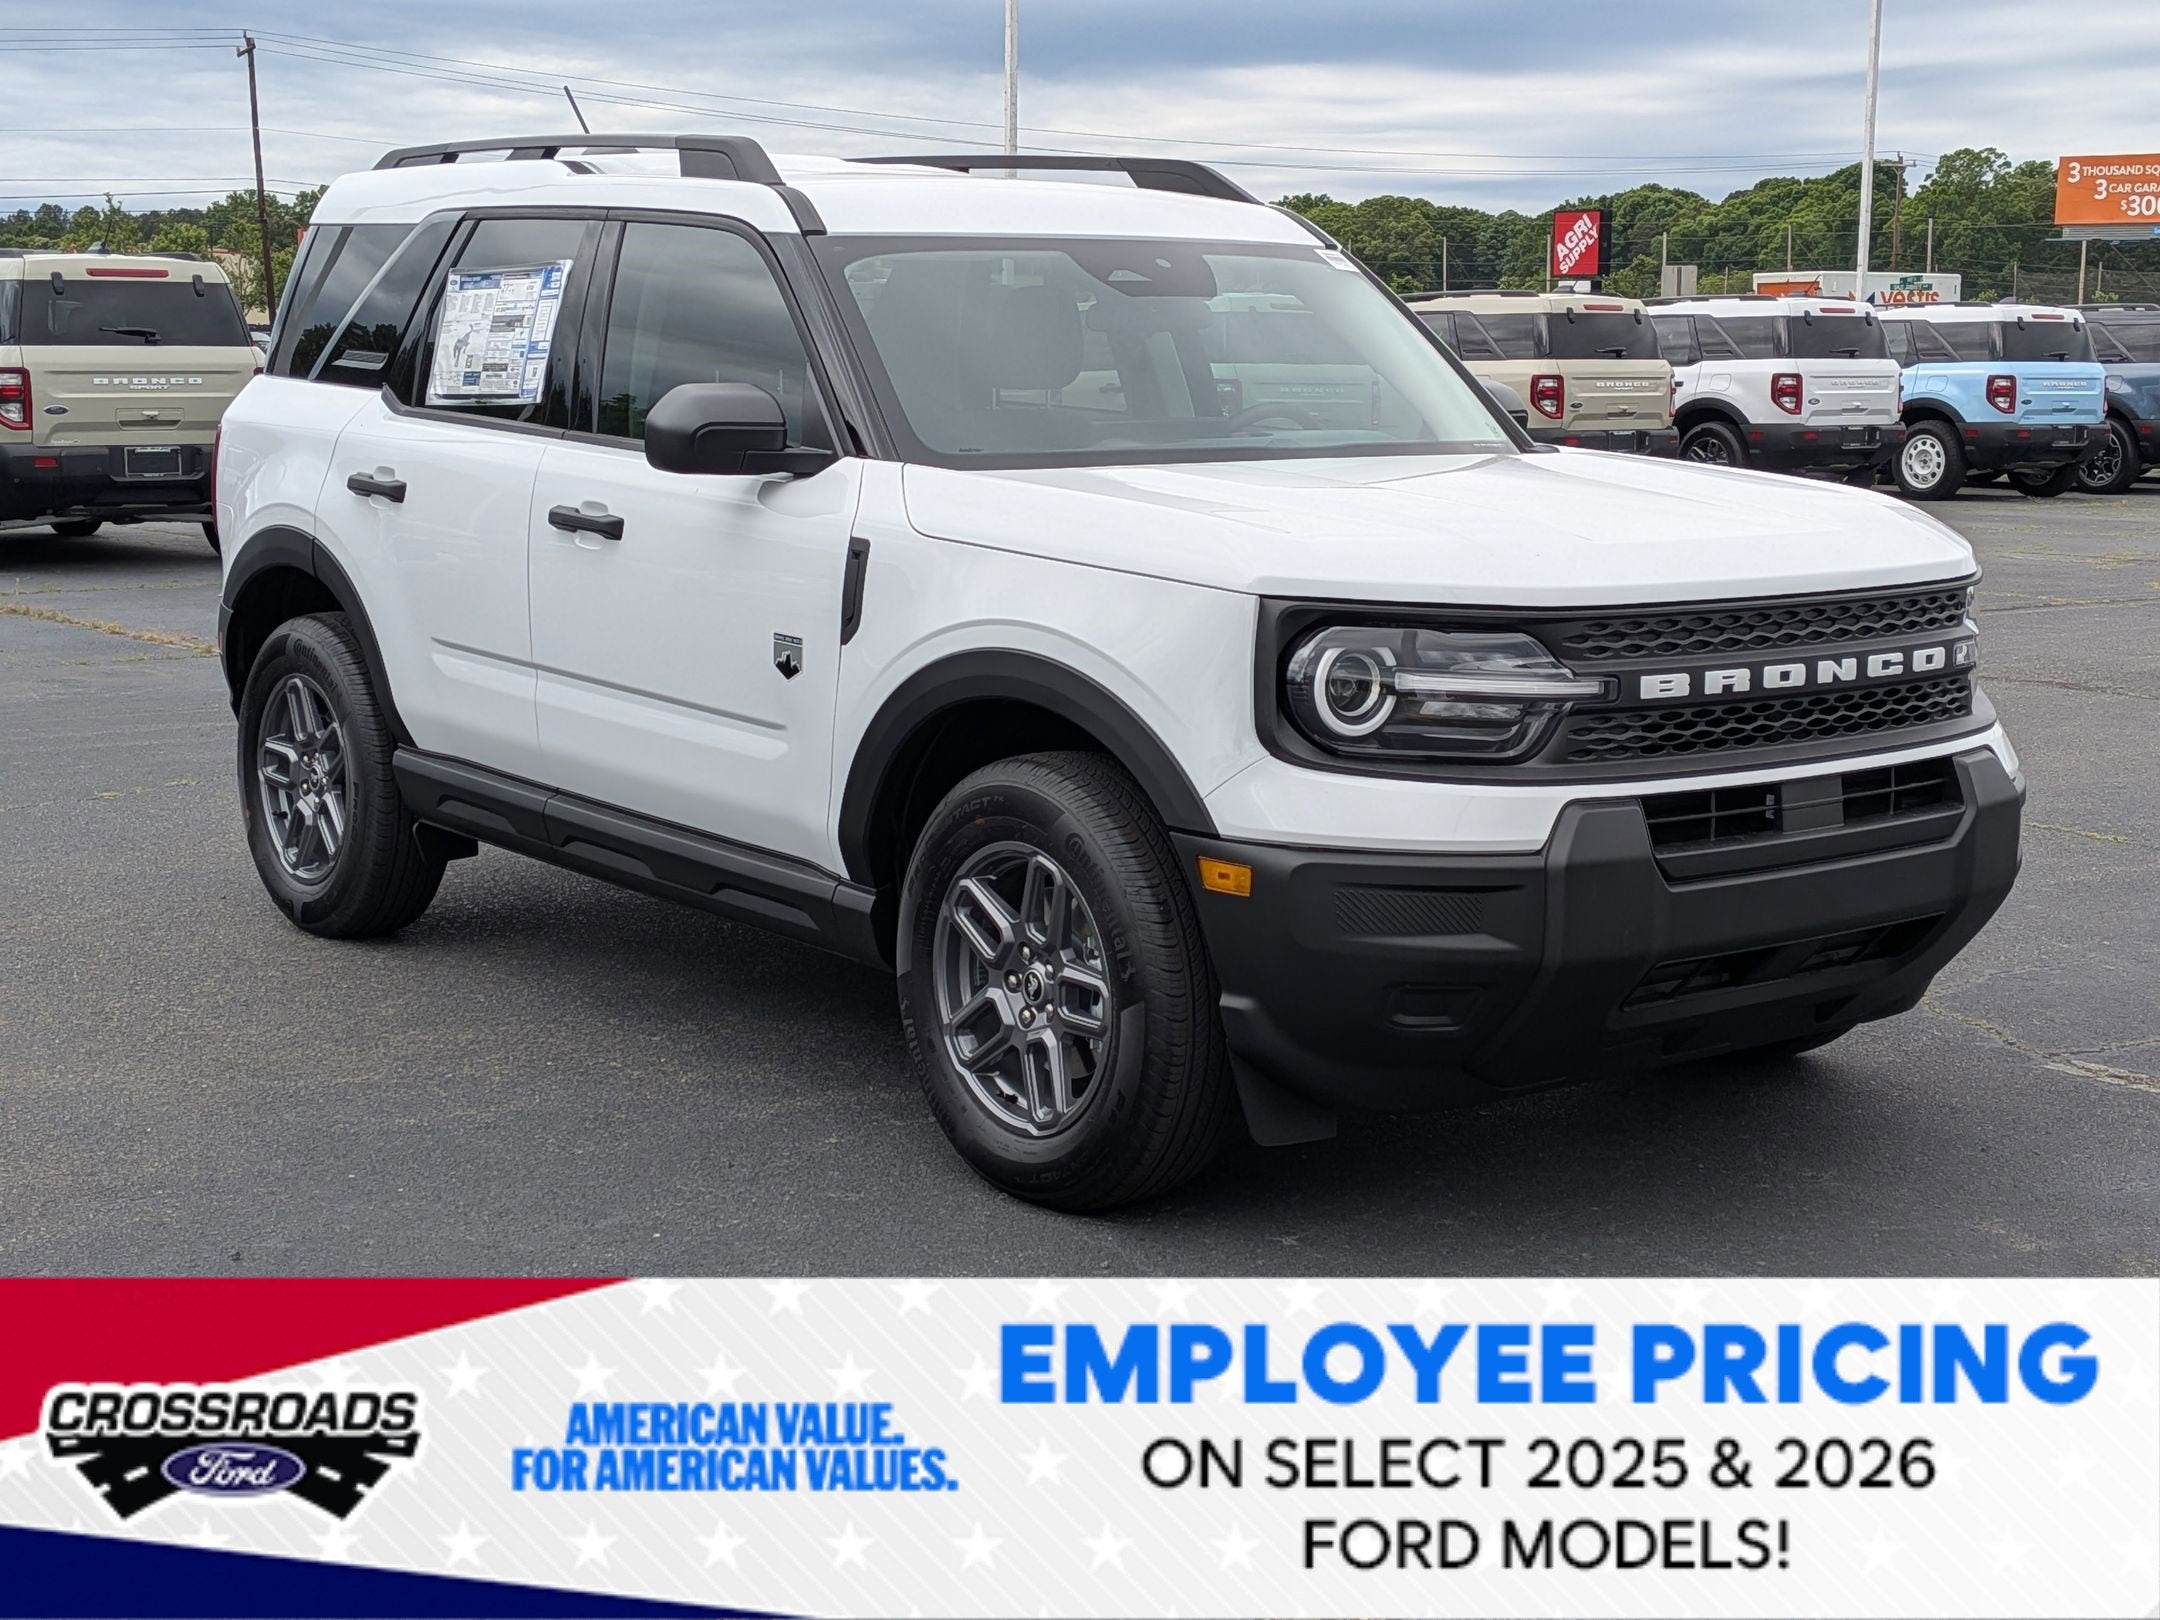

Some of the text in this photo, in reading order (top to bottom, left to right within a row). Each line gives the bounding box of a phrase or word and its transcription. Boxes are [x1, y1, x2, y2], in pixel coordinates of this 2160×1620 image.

[2067, 162, 2160, 183] 3 THOUSAND SQ
[2093, 179, 2107, 200] 3
[2109, 183, 2132, 193] CAR
[2120, 195, 2160, 217] $30
[1556, 213, 1592, 262] AGRI
[1559, 223, 1599, 275] SUPPLY
[93, 377, 203, 385] BRONCO
[1640, 646, 1946, 699] BRONCO
